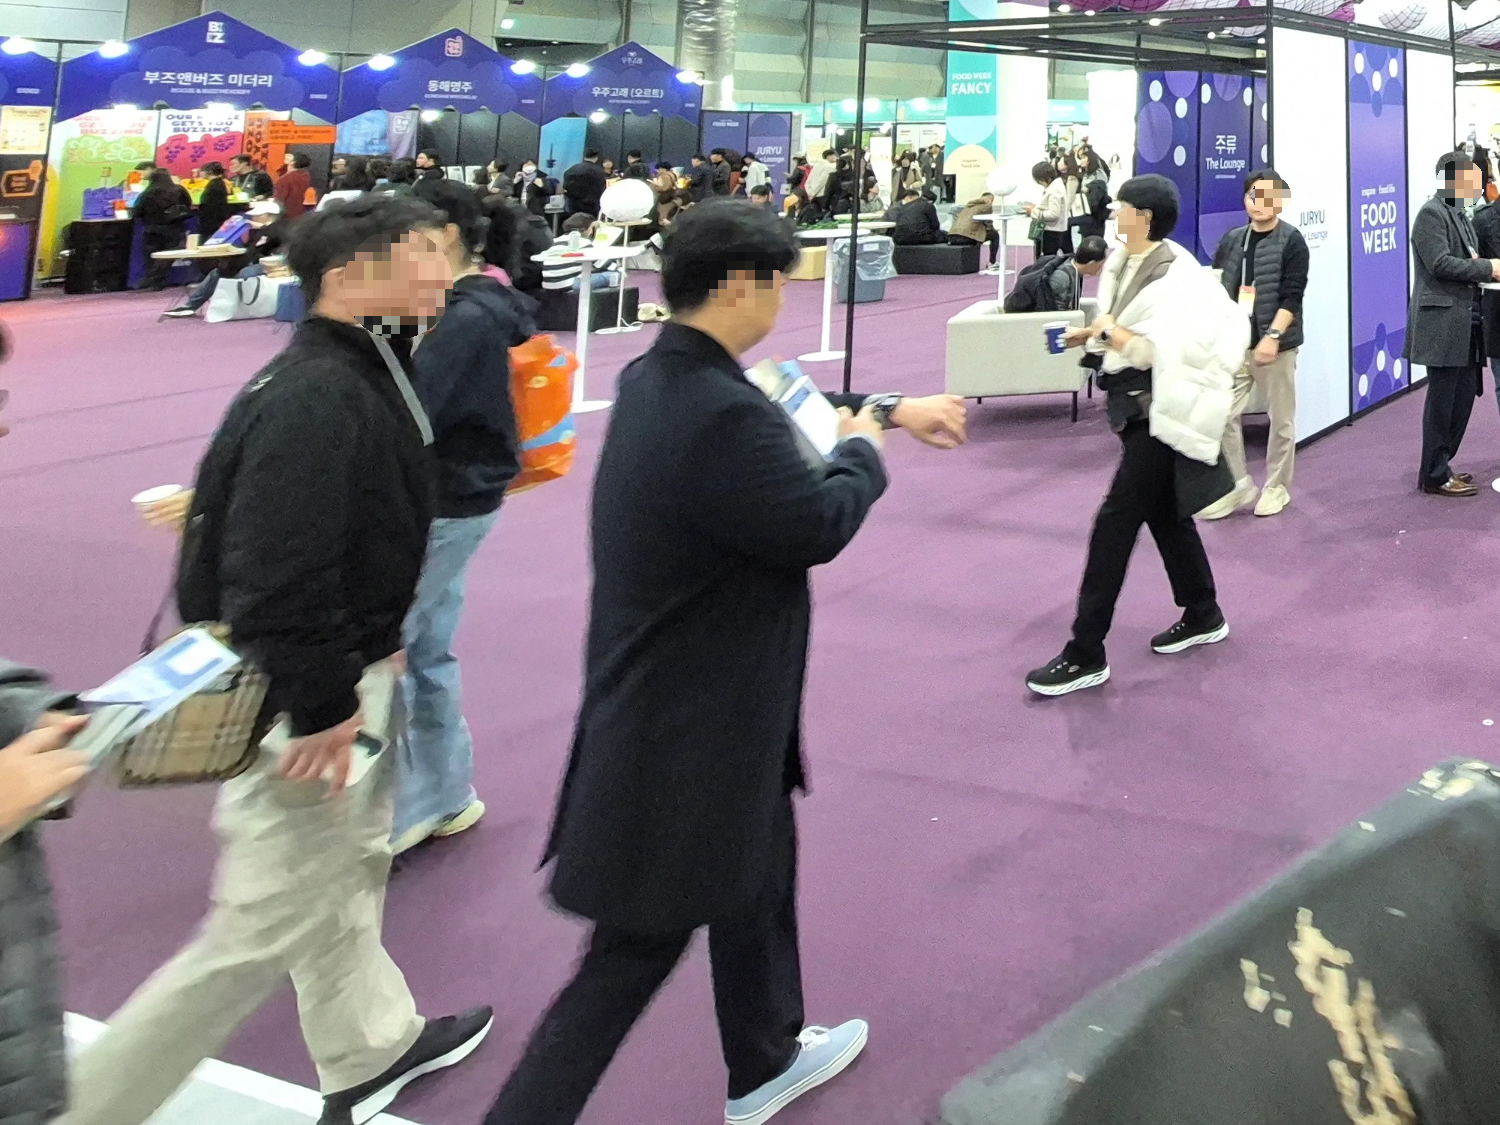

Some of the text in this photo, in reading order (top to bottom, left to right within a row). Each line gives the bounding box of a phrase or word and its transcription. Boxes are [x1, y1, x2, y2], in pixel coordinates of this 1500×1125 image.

[143, 71, 273, 88] 부즈앤버즈 미더리
[428, 80, 473, 93] 동해명주
[591, 86, 628, 97] 우주고래
[951, 82, 992, 95] FANCY
[756, 146, 782, 155] JURYU
[1215, 135, 1237, 155] 주류
[1205, 157, 1246, 172] The Lounge
[1299, 209, 1326, 227] JURYU
[1361, 201, 1397, 229] FOOD
[1307, 230, 1328, 241] Lounge
[1361, 226, 1397, 255] WEEK
